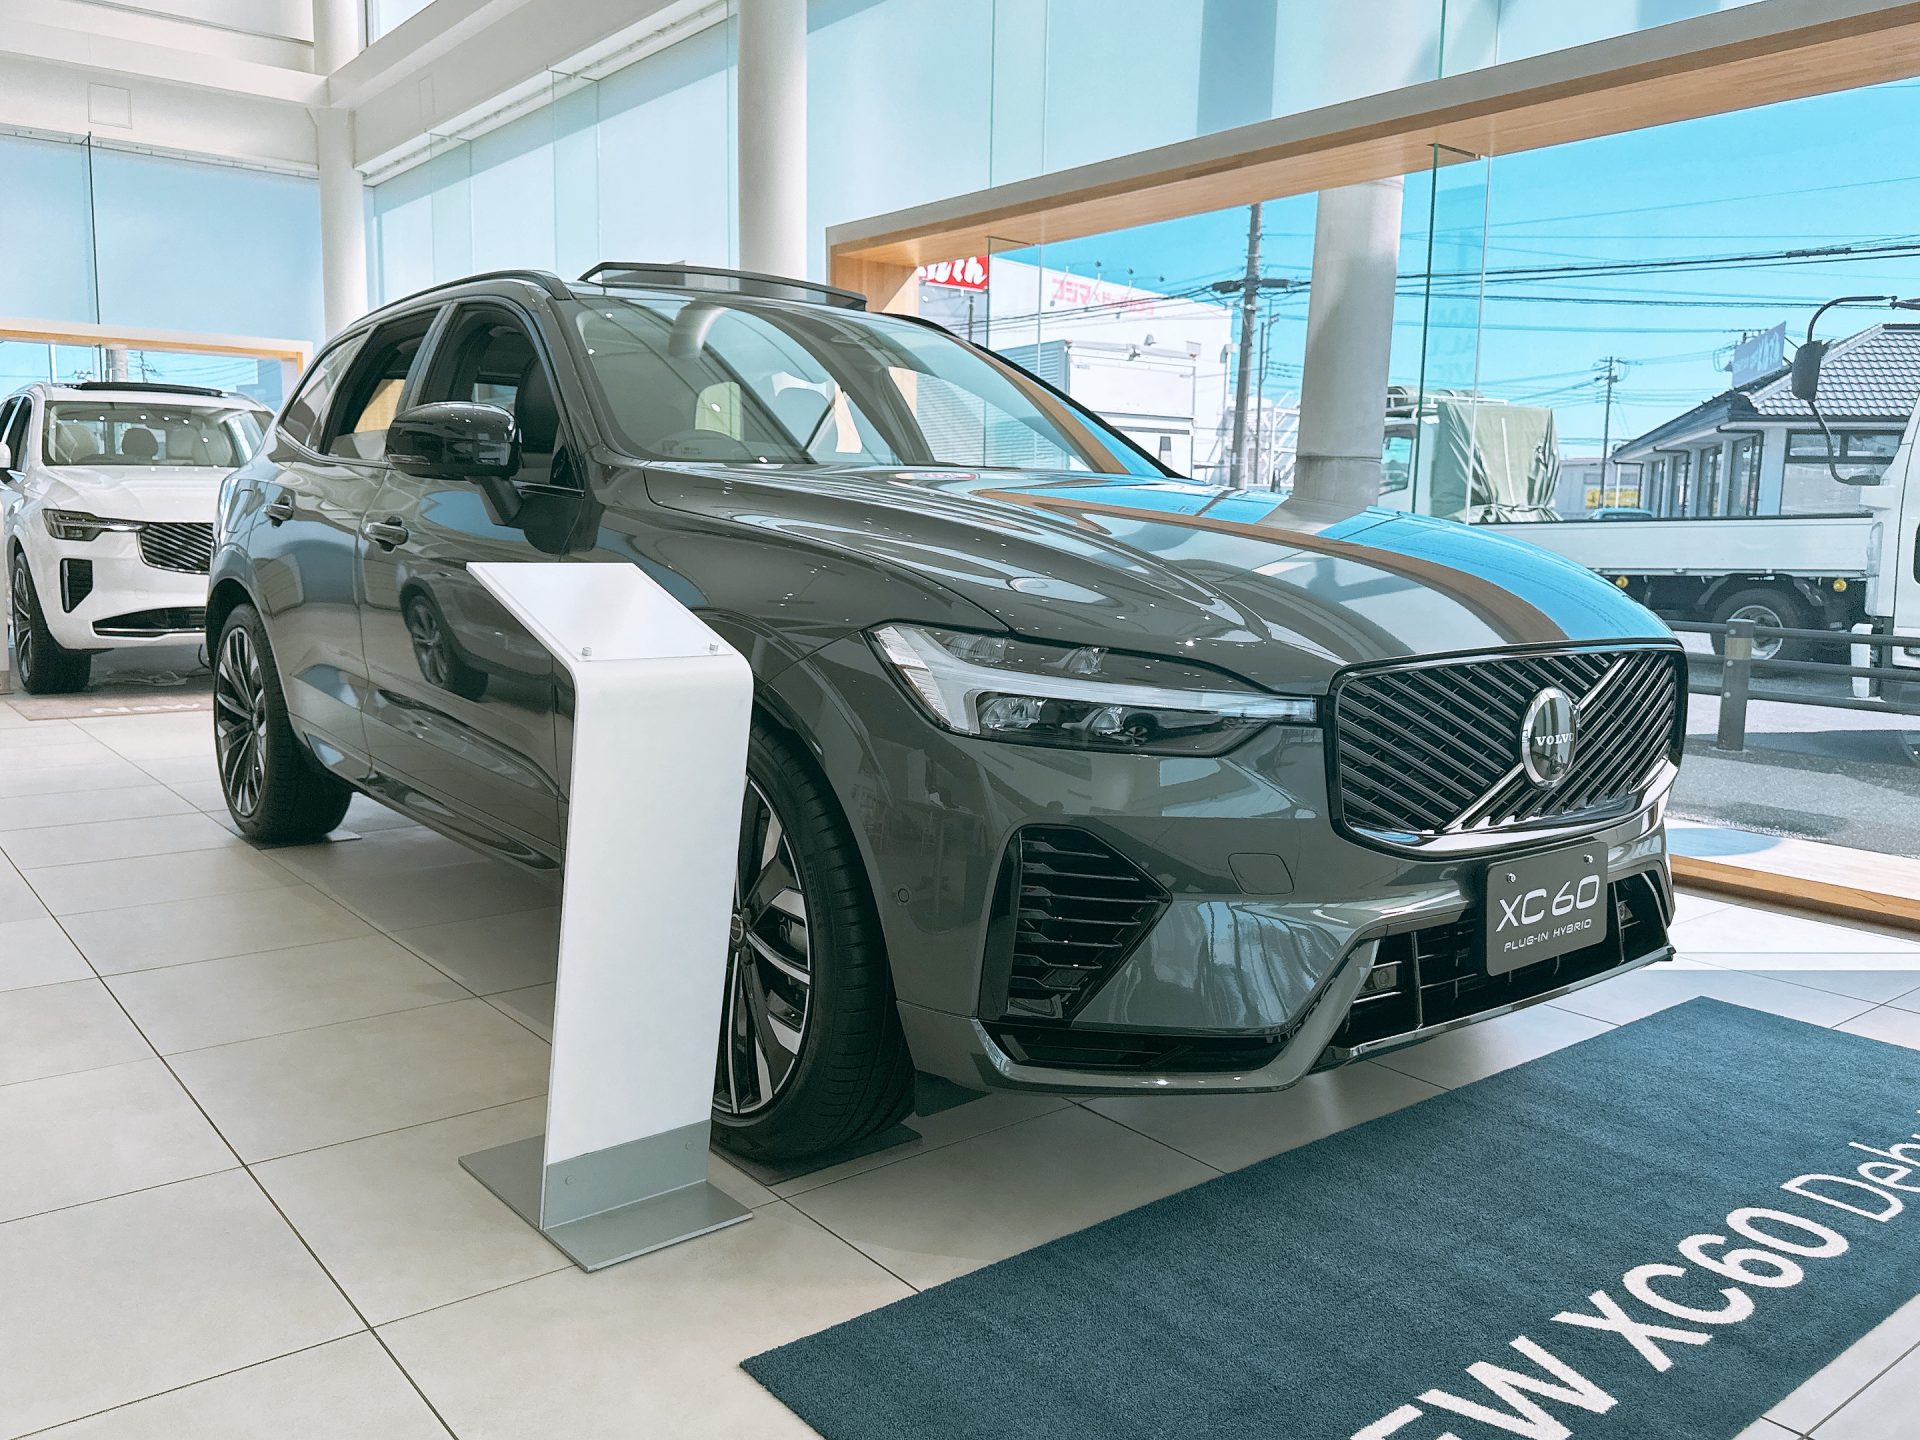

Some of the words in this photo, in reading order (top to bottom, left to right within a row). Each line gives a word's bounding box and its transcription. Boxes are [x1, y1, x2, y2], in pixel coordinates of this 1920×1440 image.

[1534, 732, 1574, 747] VOLVO
[1503, 931, 1549, 953] PLUG-IN
[1552, 918, 1592, 937] HYBRID
[1550, 1206, 1849, 1373] XC60
[1780, 1109, 1920, 1223] Deb
